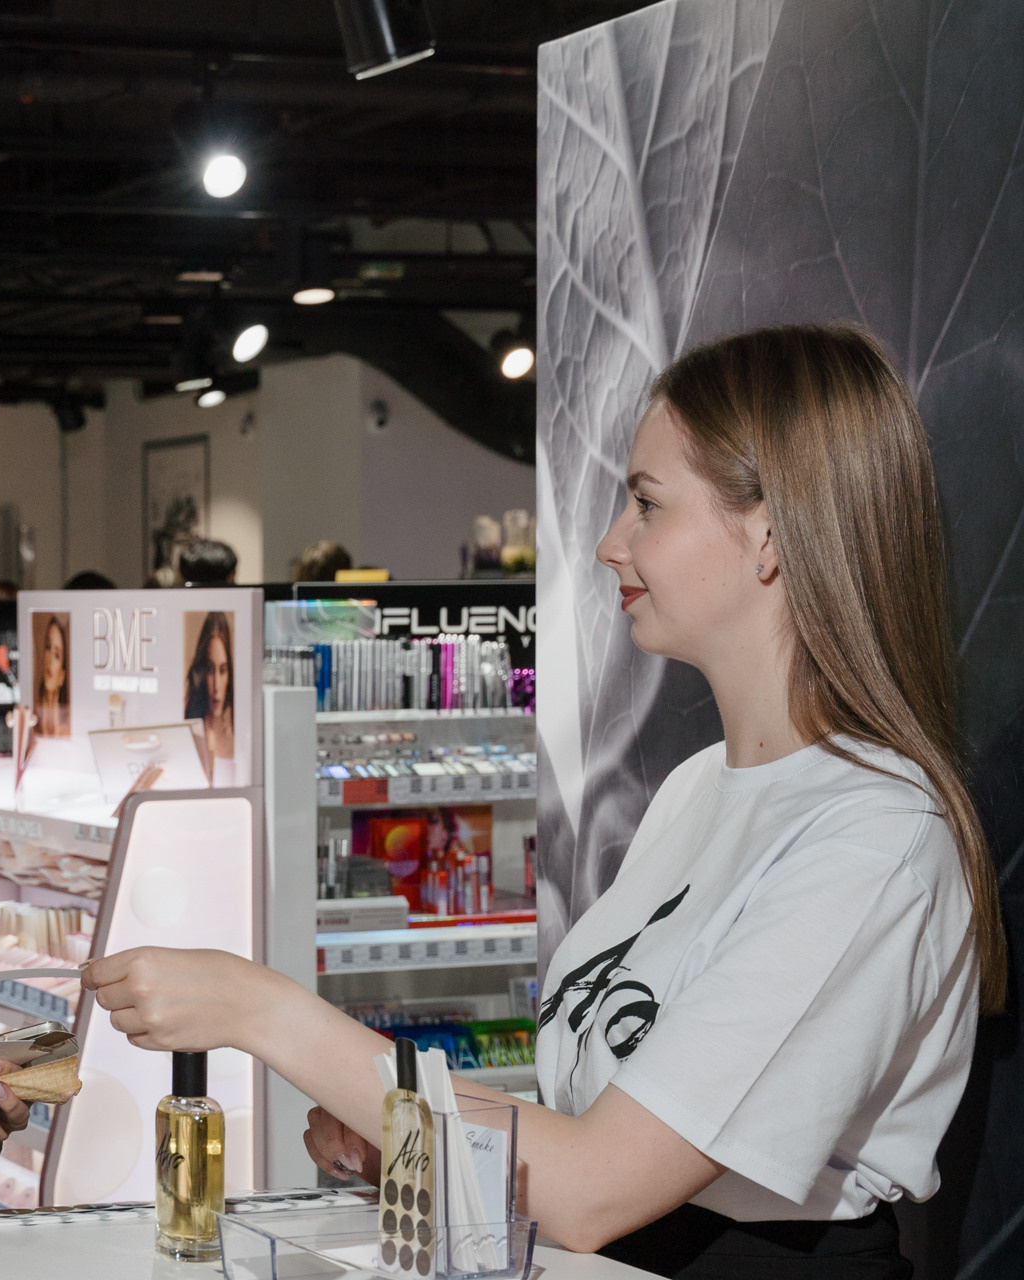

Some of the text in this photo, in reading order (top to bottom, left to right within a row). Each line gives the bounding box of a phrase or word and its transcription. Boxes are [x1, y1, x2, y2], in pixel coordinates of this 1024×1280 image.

[93, 608, 158, 672] BME
[387, 1128, 430, 1177] Akro
[465, 1130, 495, 1153] Smoke
